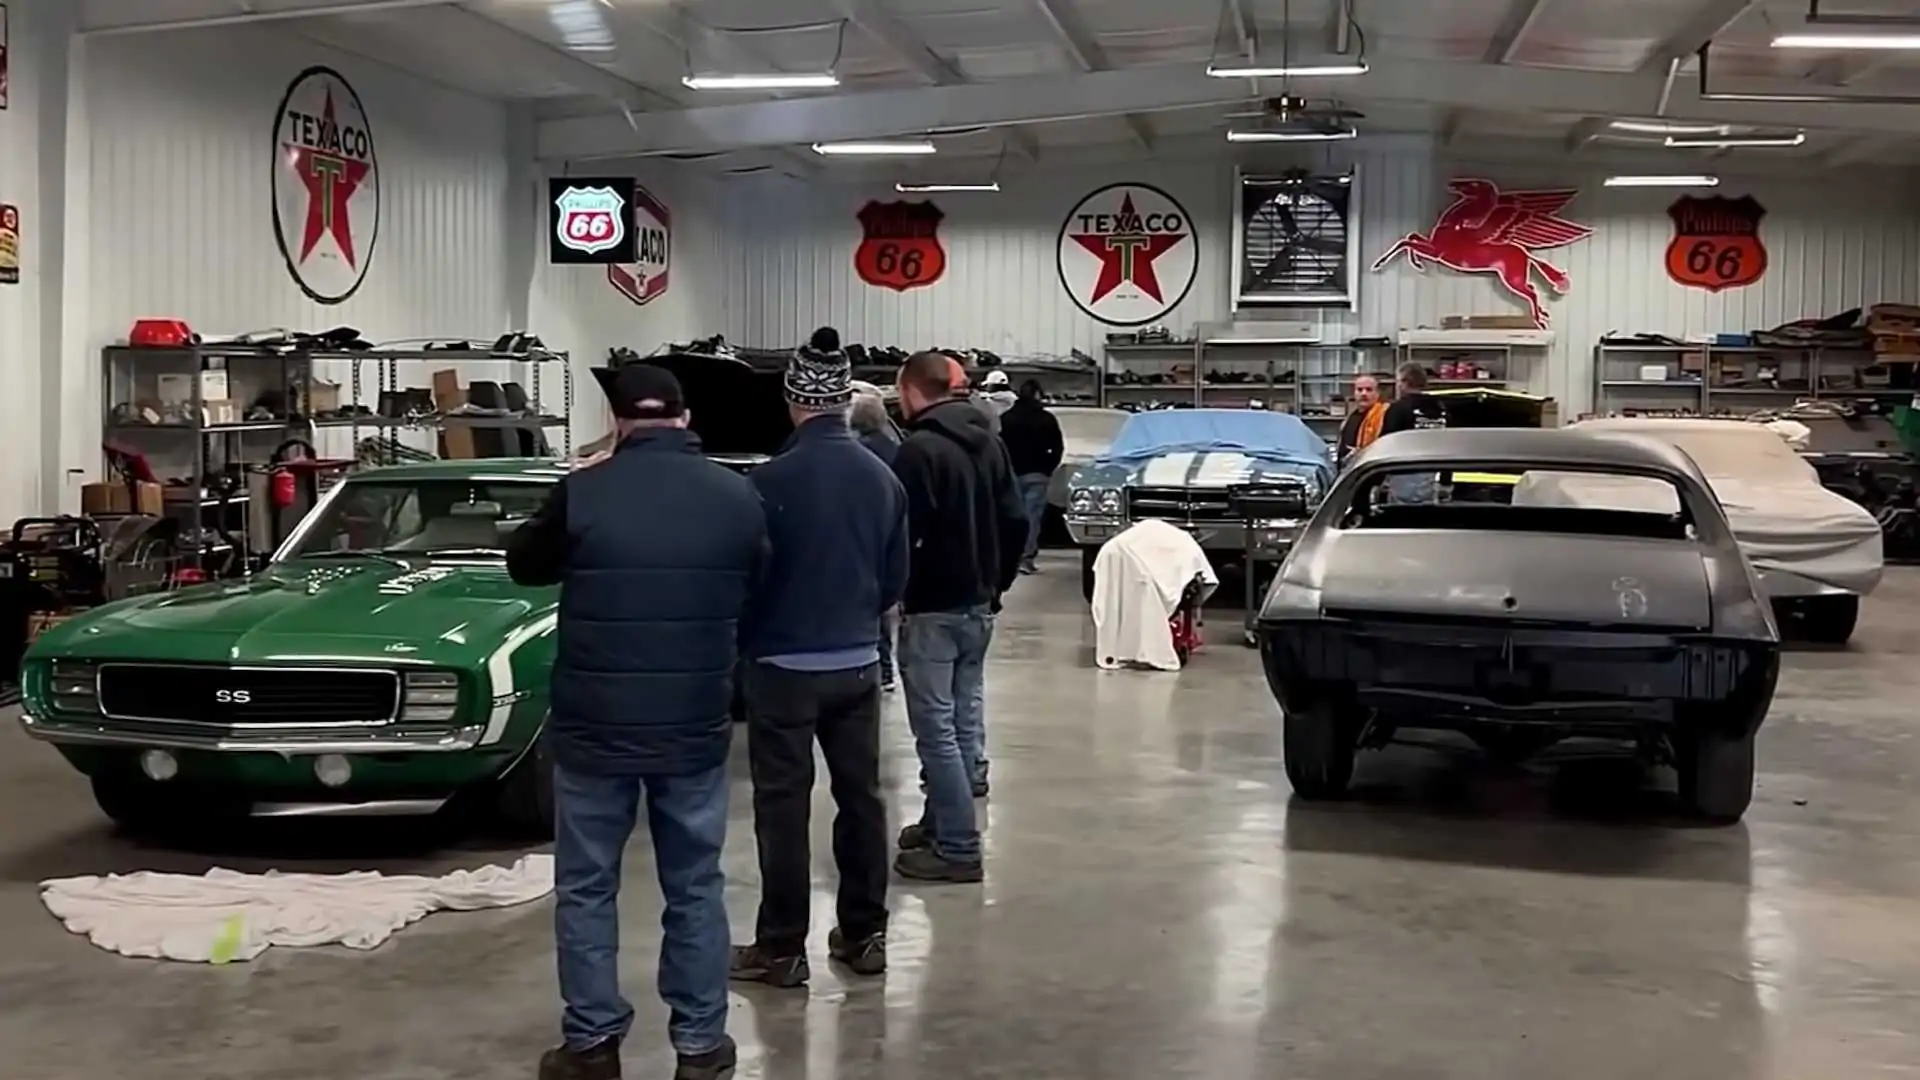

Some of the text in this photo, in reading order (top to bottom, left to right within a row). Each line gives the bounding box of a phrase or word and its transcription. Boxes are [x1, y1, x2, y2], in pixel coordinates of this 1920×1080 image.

[288, 110, 368, 159] TEXACO
[570, 214, 610, 238] 66
[1077, 213, 1183, 233] TEXACO
[636, 226, 665, 265] ACO
[876, 243, 926, 280] 66
[1687, 240, 1745, 280] 66
[215, 689, 251, 703] SS
